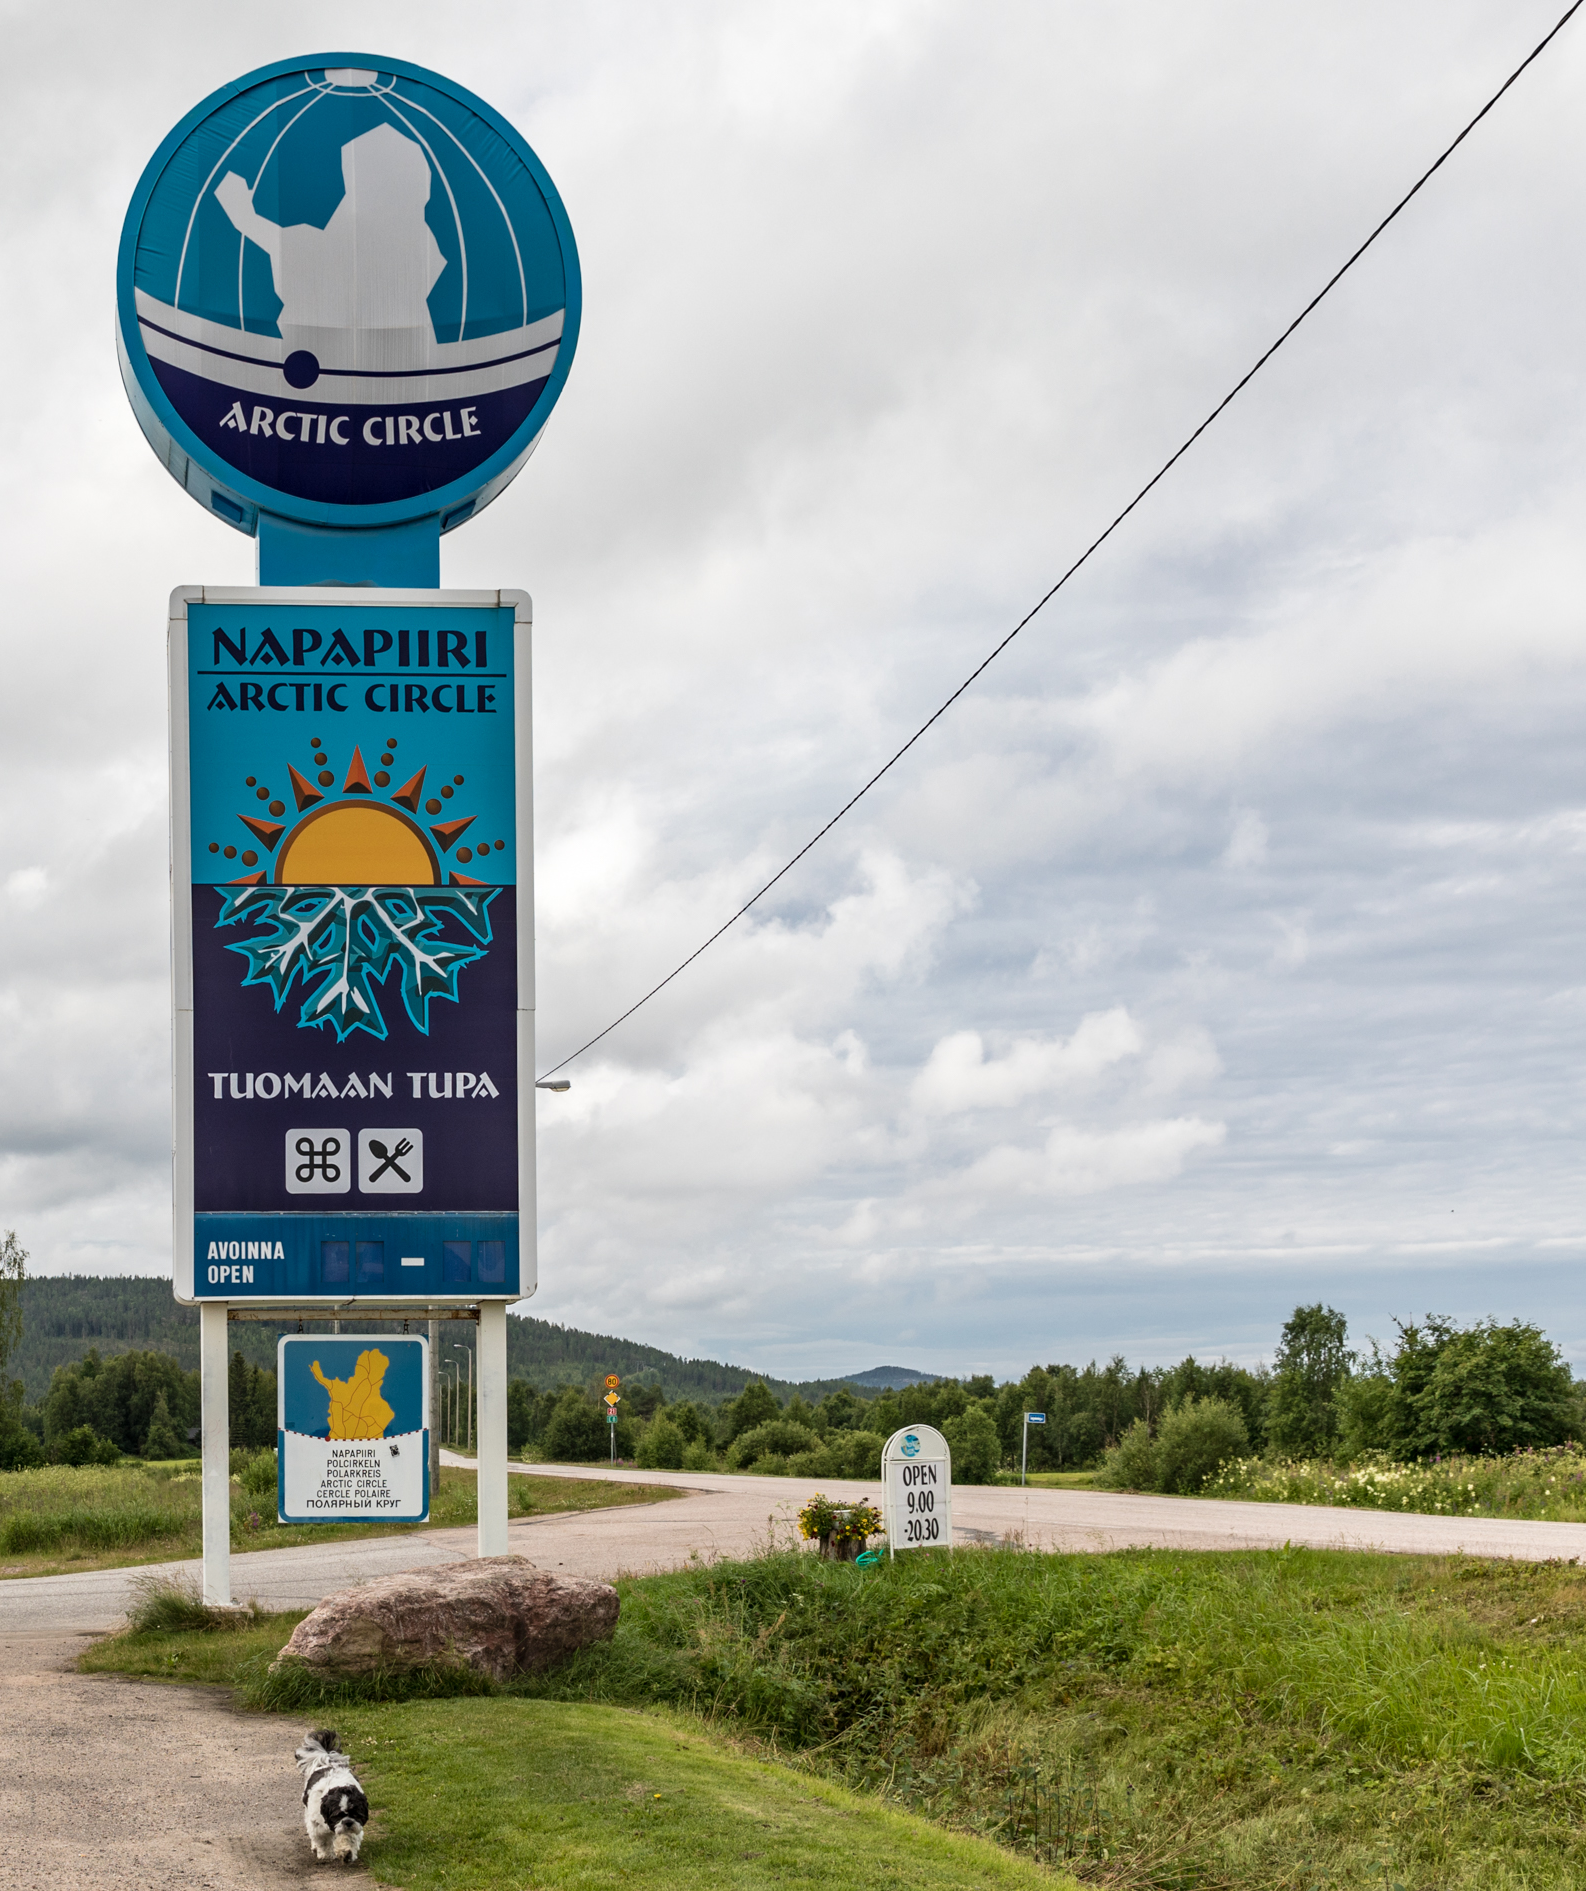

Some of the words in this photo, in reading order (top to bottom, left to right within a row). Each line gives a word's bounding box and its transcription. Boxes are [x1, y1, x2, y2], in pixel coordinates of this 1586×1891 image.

[219, 401, 351, 445] ARCTIC
[362, 406, 481, 446] CIRCLE
[211, 626, 487, 668] NAPAPIIRI
[206, 681, 349, 712] ARCTIC
[364, 683, 498, 713] CIRCLE
[207, 1071, 394, 1100] TUOMAAN
[406, 1071, 500, 1099] TUPA
[207, 1241, 285, 1260] AVOINNA
[207, 1265, 255, 1284] OPEN
[607, 1378, 617, 1386] 80
[332, 1449, 376, 1458] NAPAPIIRI
[327, 1459, 381, 1468] POLCIRKELN
[327, 1469, 381, 1478] POLARKREIS
[903, 1464, 937, 1487] OPEN
[320, 1479, 353, 1488] ARCTIC
[356, 1479, 388, 1488] CIRCLE
[306, 1498, 372, 1508] ПОЛЯРНЫЙ
[376, 1499, 402, 1508] КРУГ
[316, 1490, 351, 1498] CERCLE
[354, 1490, 391, 1498] POLAIRE
[907, 1490, 934, 1514] 9.00
[904, 1518, 939, 1542] -20.30
